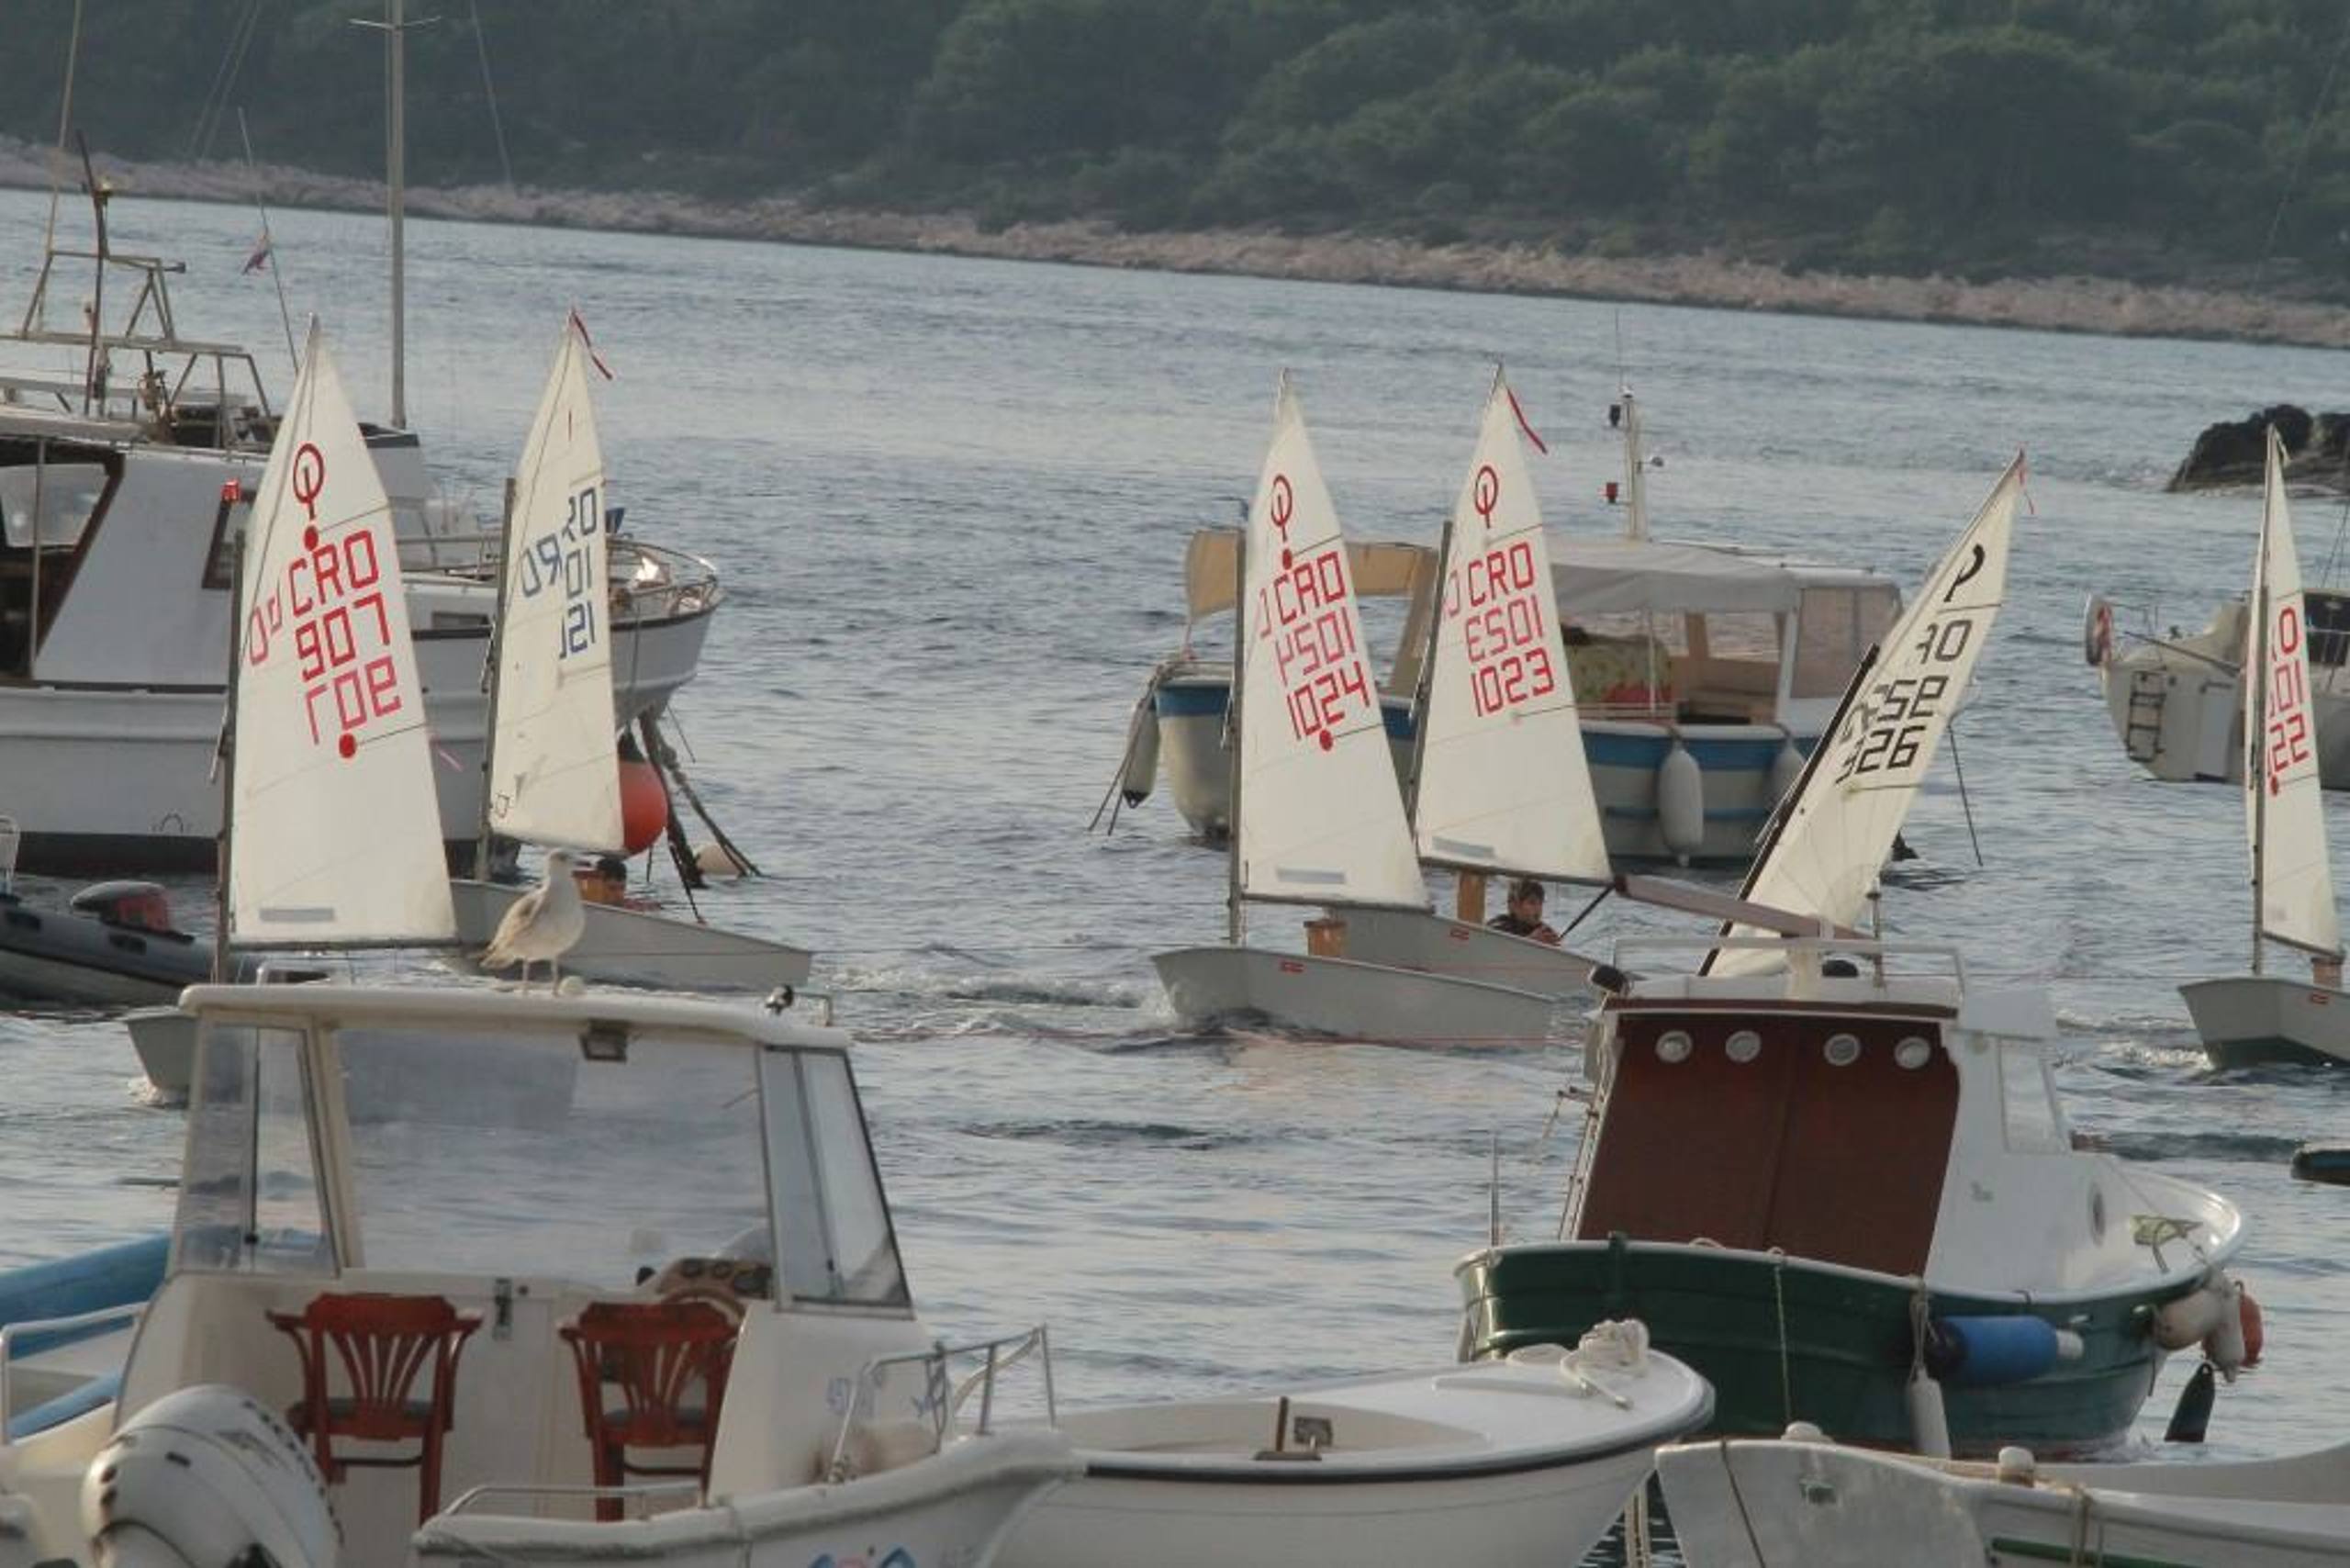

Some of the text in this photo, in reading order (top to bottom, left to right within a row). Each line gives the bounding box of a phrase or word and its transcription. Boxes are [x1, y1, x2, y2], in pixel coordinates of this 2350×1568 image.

[288, 530, 379, 618] CRO
[1273, 551, 1346, 625] CRO
[1469, 542, 1534, 607] CRO
[295, 591, 390, 682] 907
[1287, 660, 1371, 741] 1024
[1472, 647, 1554, 717] 1023
